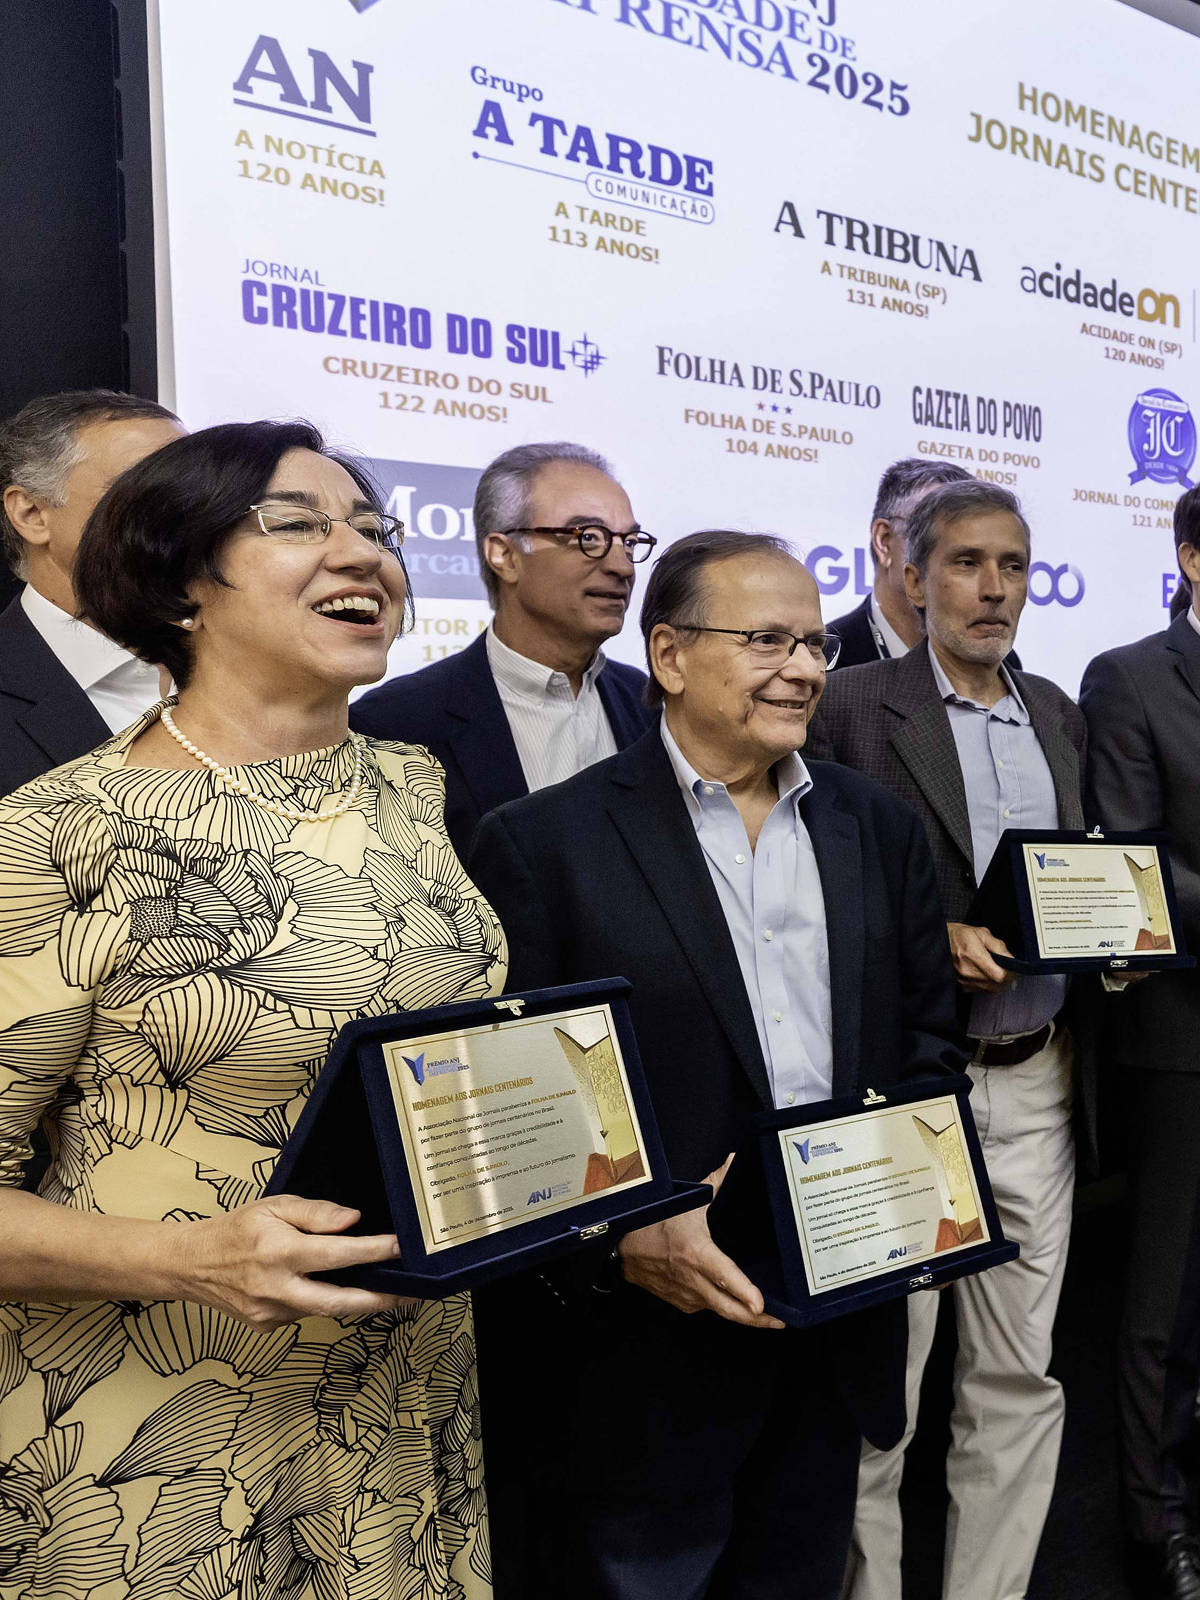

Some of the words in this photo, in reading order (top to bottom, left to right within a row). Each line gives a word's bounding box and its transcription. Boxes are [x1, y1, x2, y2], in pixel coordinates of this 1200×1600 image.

[818, 29, 857, 62] DE
[233, 34, 374, 125] AN
[470, 66, 544, 103] Grupo
[806, 52, 910, 116] 2025
[235, 129, 254, 150] A
[264, 134, 386, 179] NOTÍCIA
[471, 100, 513, 144] A
[528, 112, 714, 197] TARDE
[969, 112, 1105, 183] JORNAIS
[237, 159, 291, 187] 120
[300, 173, 386, 207] ANOS!
[594, 178, 709, 220] COMUNICAÇÃO
[555, 201, 570, 221] A
[575, 203, 646, 236] TARDE
[547, 226, 588, 249] 113
[596, 236, 660, 265] ANOS!
[774, 201, 806, 238] A
[816, 209, 983, 283] TRIBUNA
[241, 258, 326, 287] JORNAL
[821, 260, 833, 277] A
[837, 264, 911, 297] TRIBUNA
[916, 280, 947, 304] (SP)
[846, 289, 877, 309] 131
[881, 295, 929, 319] ANOS!
[241, 280, 431, 349] CRUZEIRO
[446, 313, 492, 359] DO
[505, 323, 566, 371] SUL
[1080, 323, 1136, 345] ACIDADE
[1138, 336, 1156, 351] ON
[1160, 339, 1183, 358] (SP)
[1104, 347, 1126, 362] 120
[1129, 352, 1164, 370] ANOS!
[323, 356, 459, 389] CRUZEIRO
[468, 375, 503, 396] DO
[510, 383, 554, 403] SUL
[656, 345, 745, 388] FOLHA
[752, 365, 783, 394] DE
[789, 369, 881, 409] S.PAULO
[378, 392, 425, 413] 122
[433, 398, 509, 423] ANOS!
[913, 385, 971, 433] GAZETA
[976, 396, 997, 436] DO
[1003, 401, 1042, 442] POVO
[685, 408, 746, 432] FOLHA
[752, 419, 776, 436] DE
[782, 423, 854, 445] S.PAULO
[725, 438, 759, 456] 104
[764, 444, 819, 464] ANOS!
[918, 440, 974, 460] GAZETA
[979, 448, 999, 463] DO
[1004, 452, 1040, 468] POVO
[1073, 488, 1120, 506] JORNAL
[1124, 495, 1140, 508] DO
[1132, 515, 1152, 527] 121
[426, 1059, 449, 1068] PRÊMIO
[412, 1094, 453, 1111] HOMENAGEM
[453, 1091, 467, 1101] AOS
[467, 1085, 494, 1098] JORNAIS
[493, 1075, 533, 1092] CENTENÁRIOS
[430, 1133, 444, 1141] fazer
[466, 1124, 482, 1132] grupo
[452, 1113, 475, 1123] Nacional
[457, 1142, 473, 1151] chega
[494, 1144, 509, 1153] longo
[799, 1171, 830, 1184] HOMENAGEM
[841, 1164, 862, 1174] JORNAIS
[525, 1187, 553, 1205] ANJ
[885, 1246, 907, 1260] ANJ
